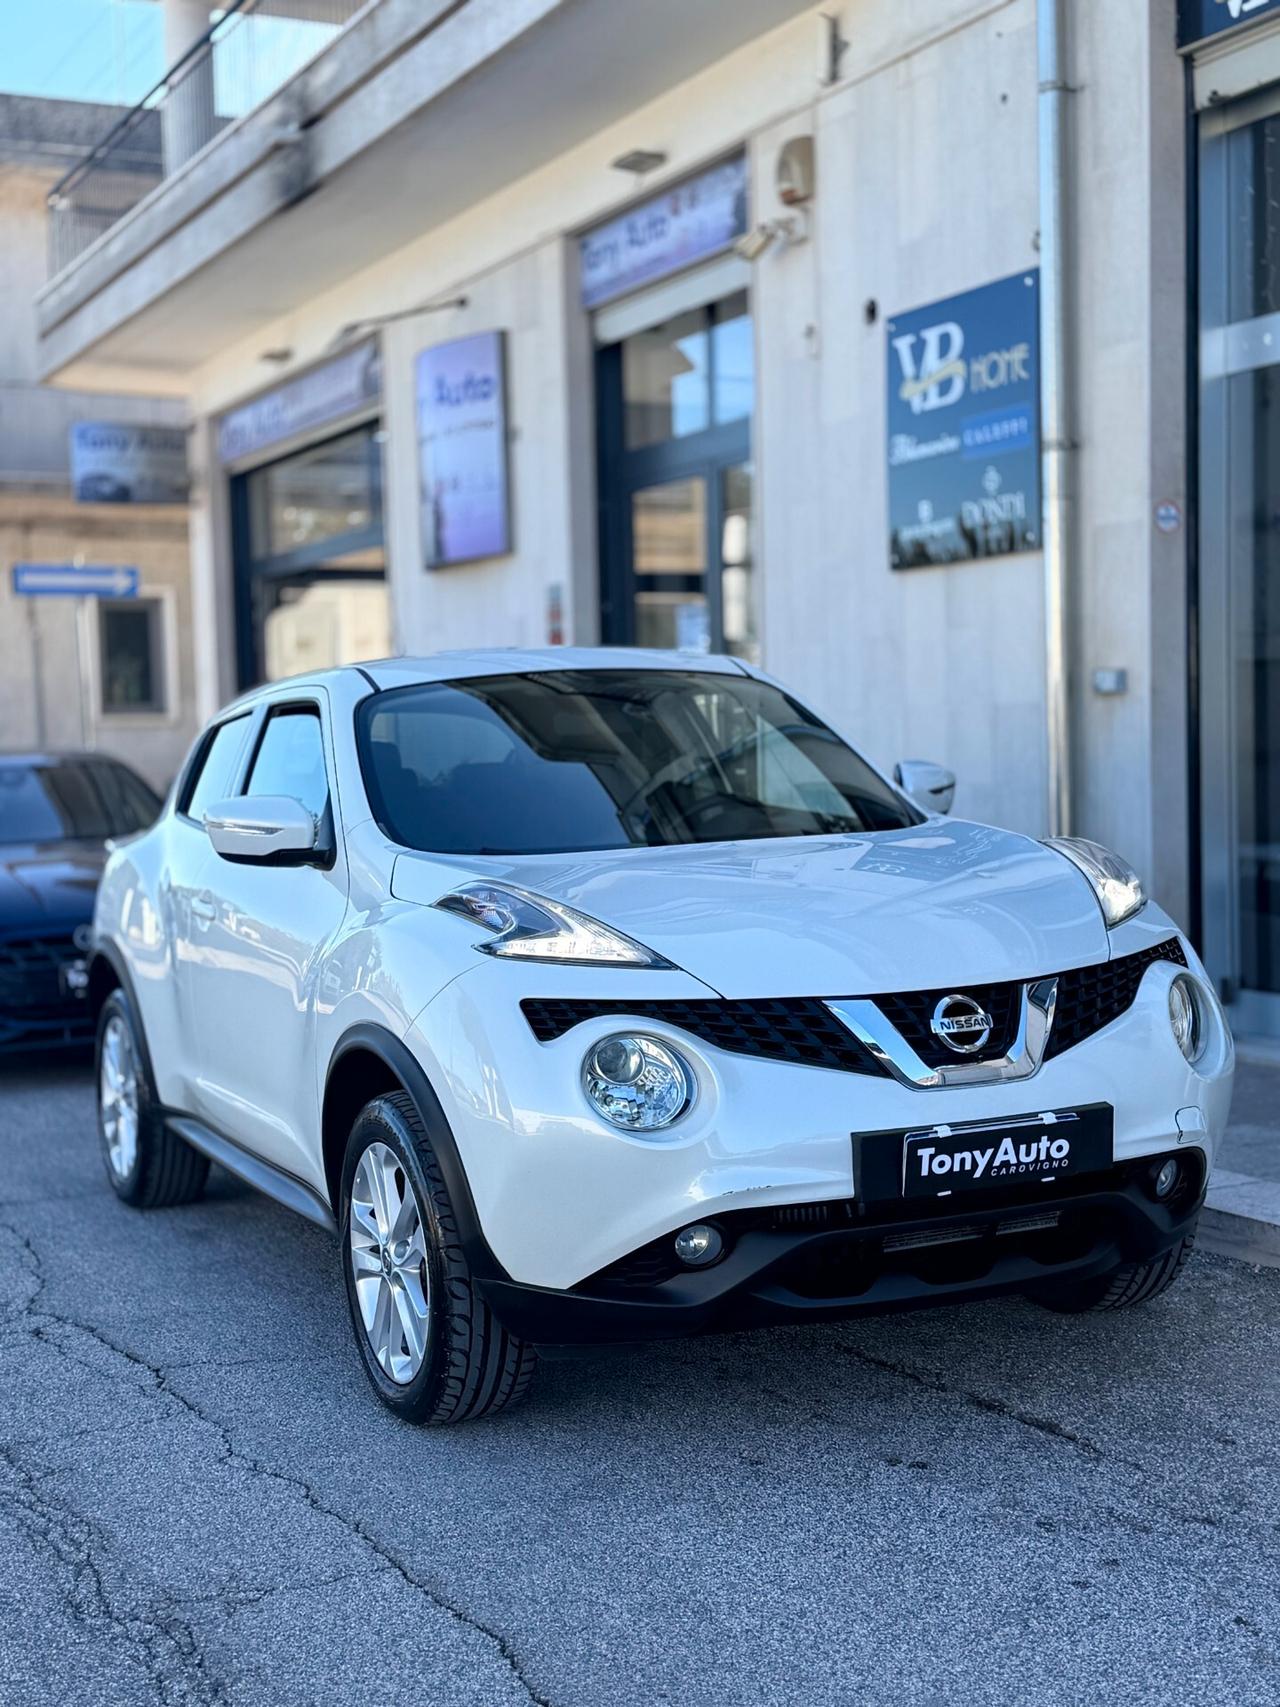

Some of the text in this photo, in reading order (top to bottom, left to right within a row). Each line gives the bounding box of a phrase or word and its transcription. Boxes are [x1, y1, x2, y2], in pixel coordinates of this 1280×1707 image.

[970, 342, 1030, 394] HOME
[435, 371, 496, 408] Auto
[939, 1016, 991, 1031] NISSAN
[990, 1159, 1069, 1176] CAROVIGNO
